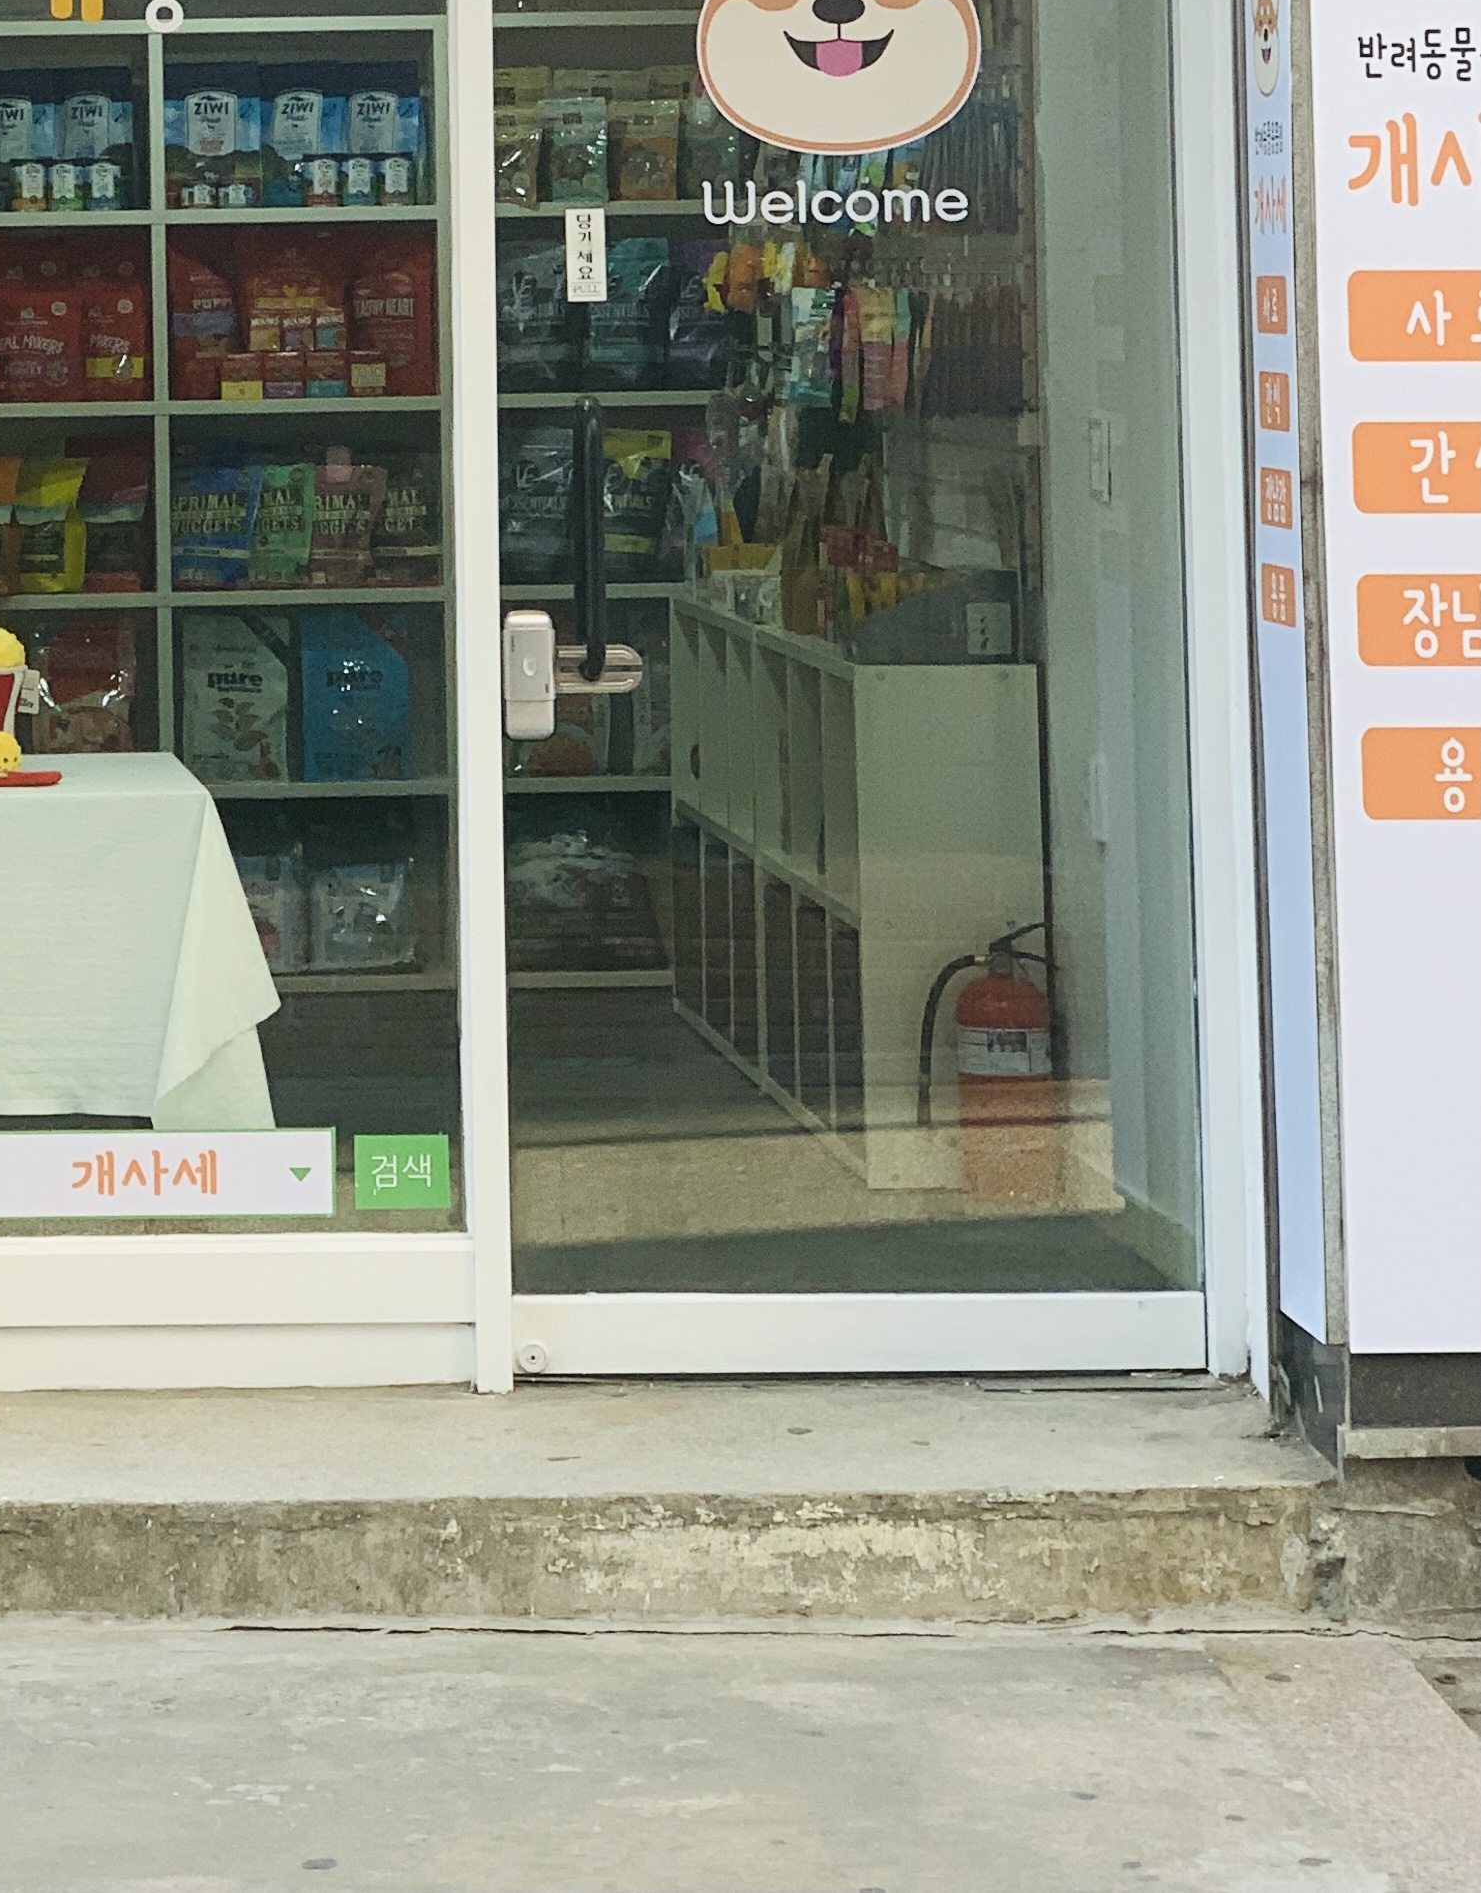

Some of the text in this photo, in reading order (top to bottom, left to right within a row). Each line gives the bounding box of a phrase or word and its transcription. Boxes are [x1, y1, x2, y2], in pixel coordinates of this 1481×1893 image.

[1357, 27, 1481, 82] 반려동물
[70, 105, 103, 119] ZIWI
[193, 102, 230, 116] ZIWI
[281, 101, 314, 115] ZIWI
[356, 101, 391, 116] ZIWI
[701, 179, 970, 226] Welcome
[572, 283, 600, 295] PULL
[71, 1149, 218, 1197] 개사세
[370, 1153, 434, 1191] 검색
